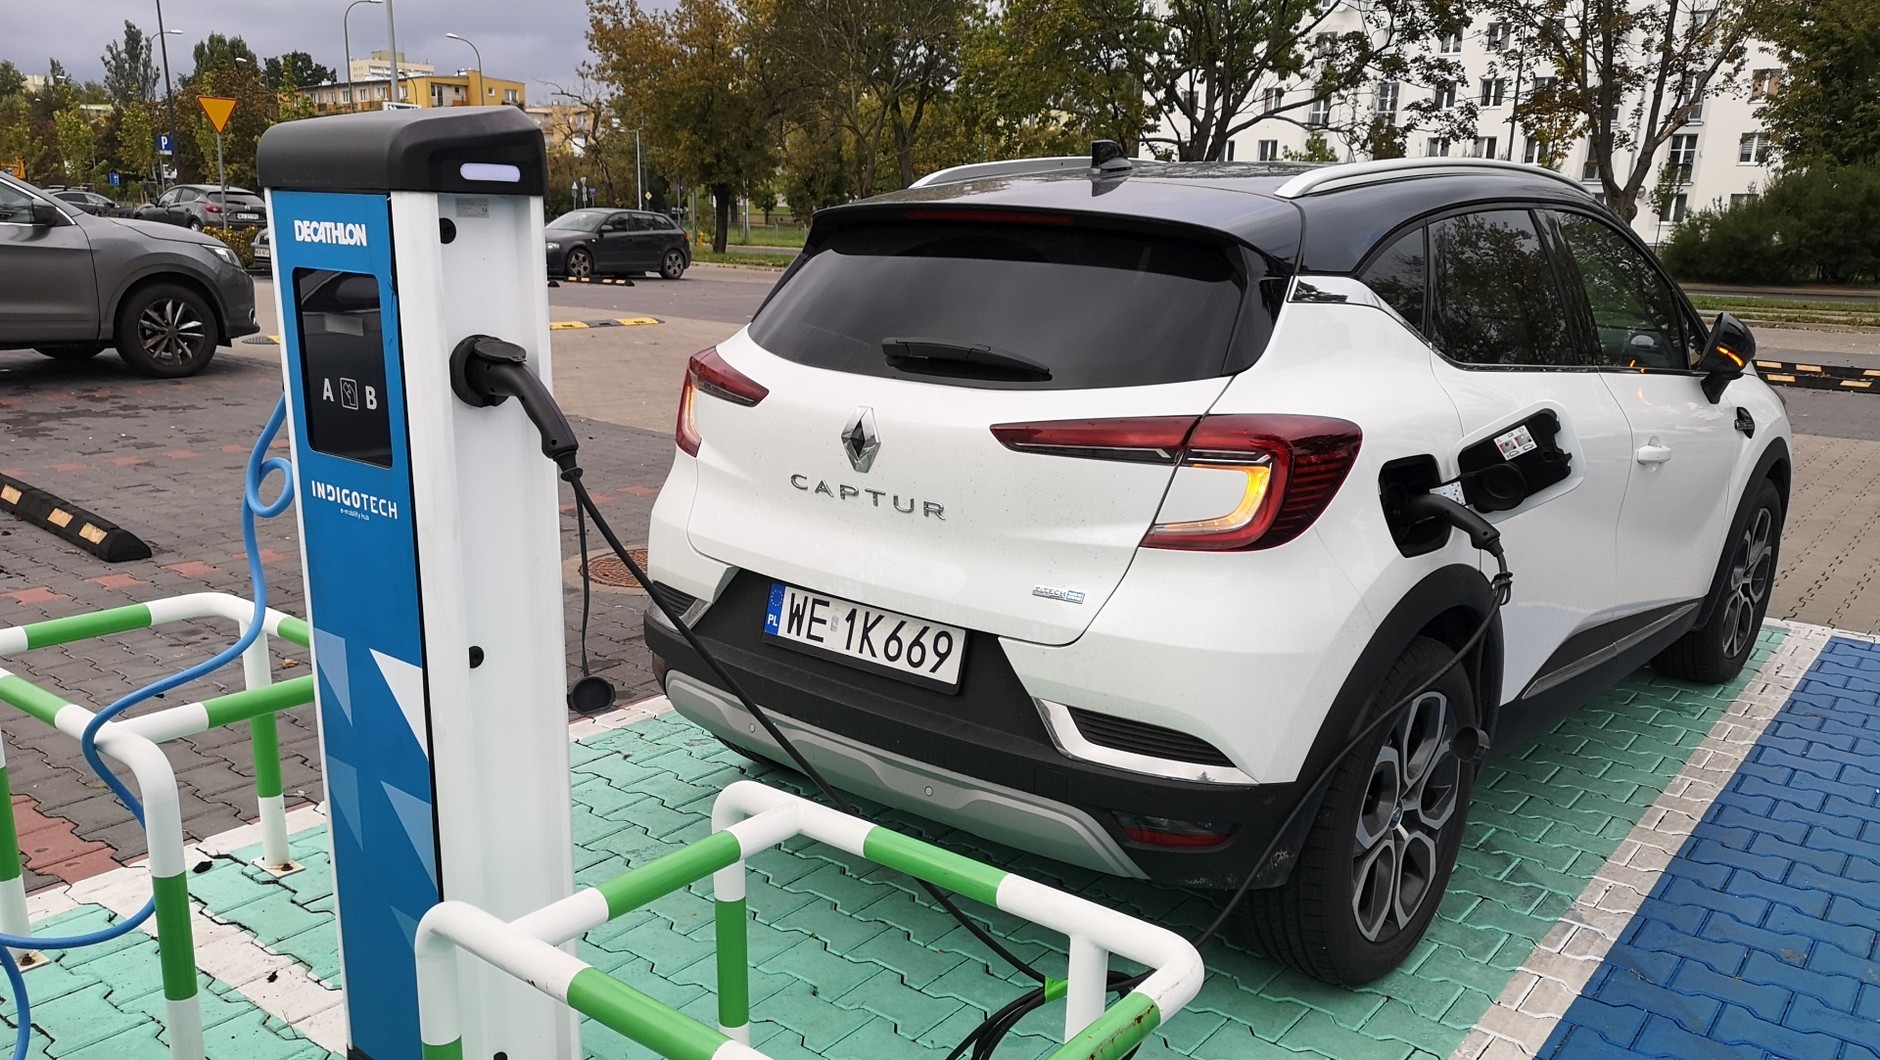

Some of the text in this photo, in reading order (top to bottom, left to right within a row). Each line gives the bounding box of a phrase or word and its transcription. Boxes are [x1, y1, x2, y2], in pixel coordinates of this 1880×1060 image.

[161, 136, 168, 150] P
[294, 219, 367, 247] DECATHLON
[322, 377, 378, 410] A B
[311, 480, 398, 520] INDIGOTECH
[790, 473, 946, 521] CAPTUR
[361, 512, 370, 521] hub
[767, 613, 778, 627] PL
[786, 592, 954, 674] WE 1K669
